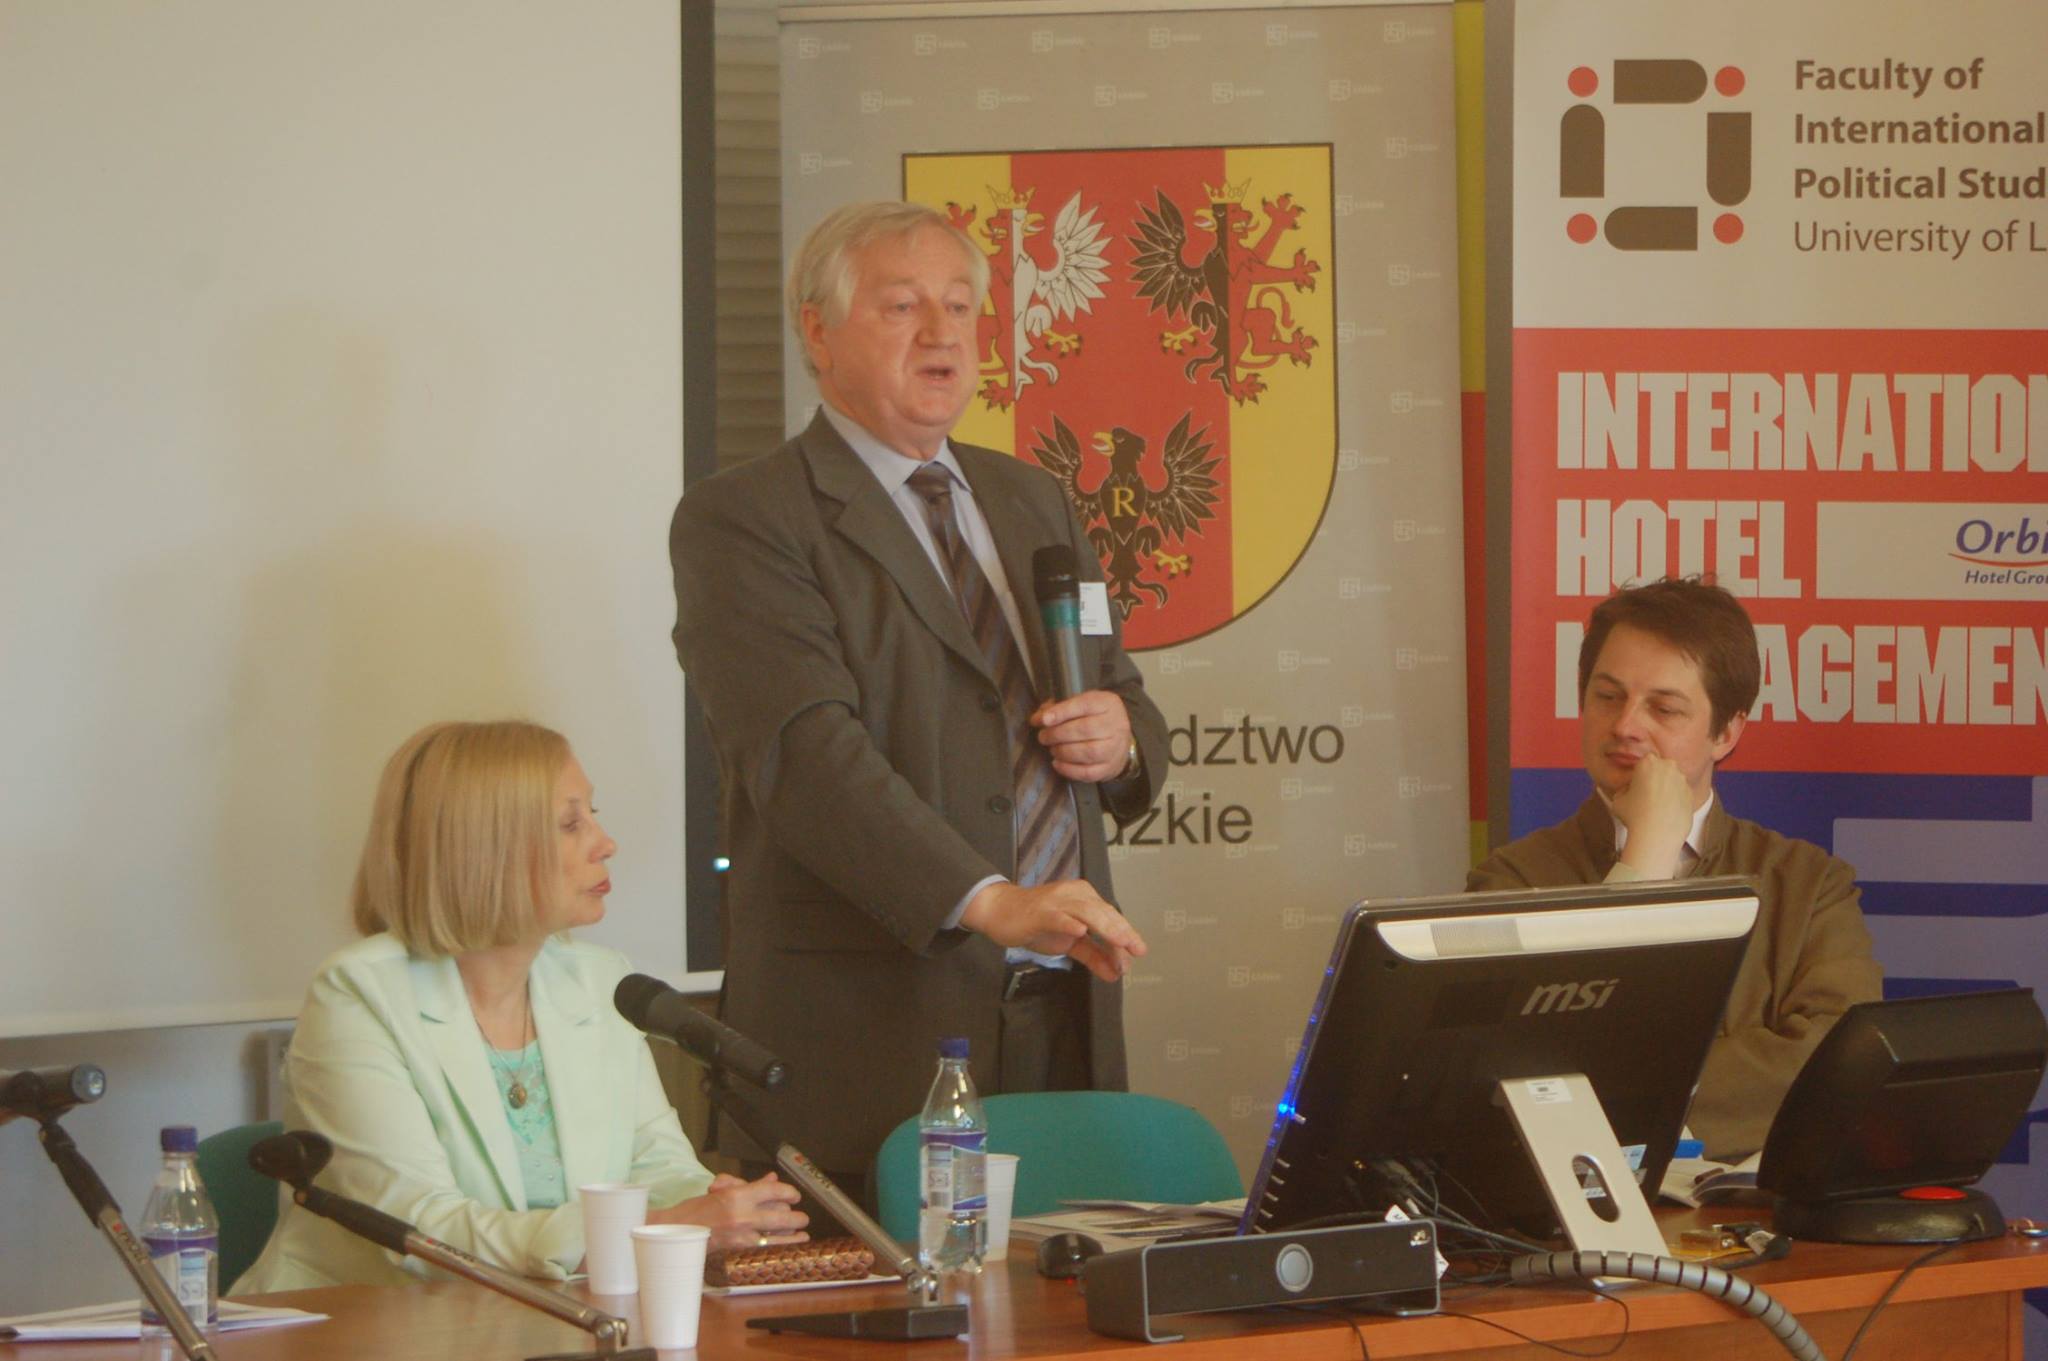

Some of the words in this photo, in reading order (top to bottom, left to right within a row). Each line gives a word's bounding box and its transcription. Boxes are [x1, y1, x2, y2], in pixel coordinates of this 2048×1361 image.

[1794, 58, 1934, 99] Faculty
[1944, 57, 1985, 91] of
[1794, 112, 2046, 144] International
[1794, 167, 1947, 199] Political
[1794, 221, 1971, 260] University
[1981, 219, 2020, 252] of
[1112, 487, 1138, 518] R
[1556, 499, 1802, 600] HOTEL
[1964, 569, 2011, 585] Hotel
[2013, 569, 2048, 585] Gro
[1520, 978, 1620, 1016] msi
